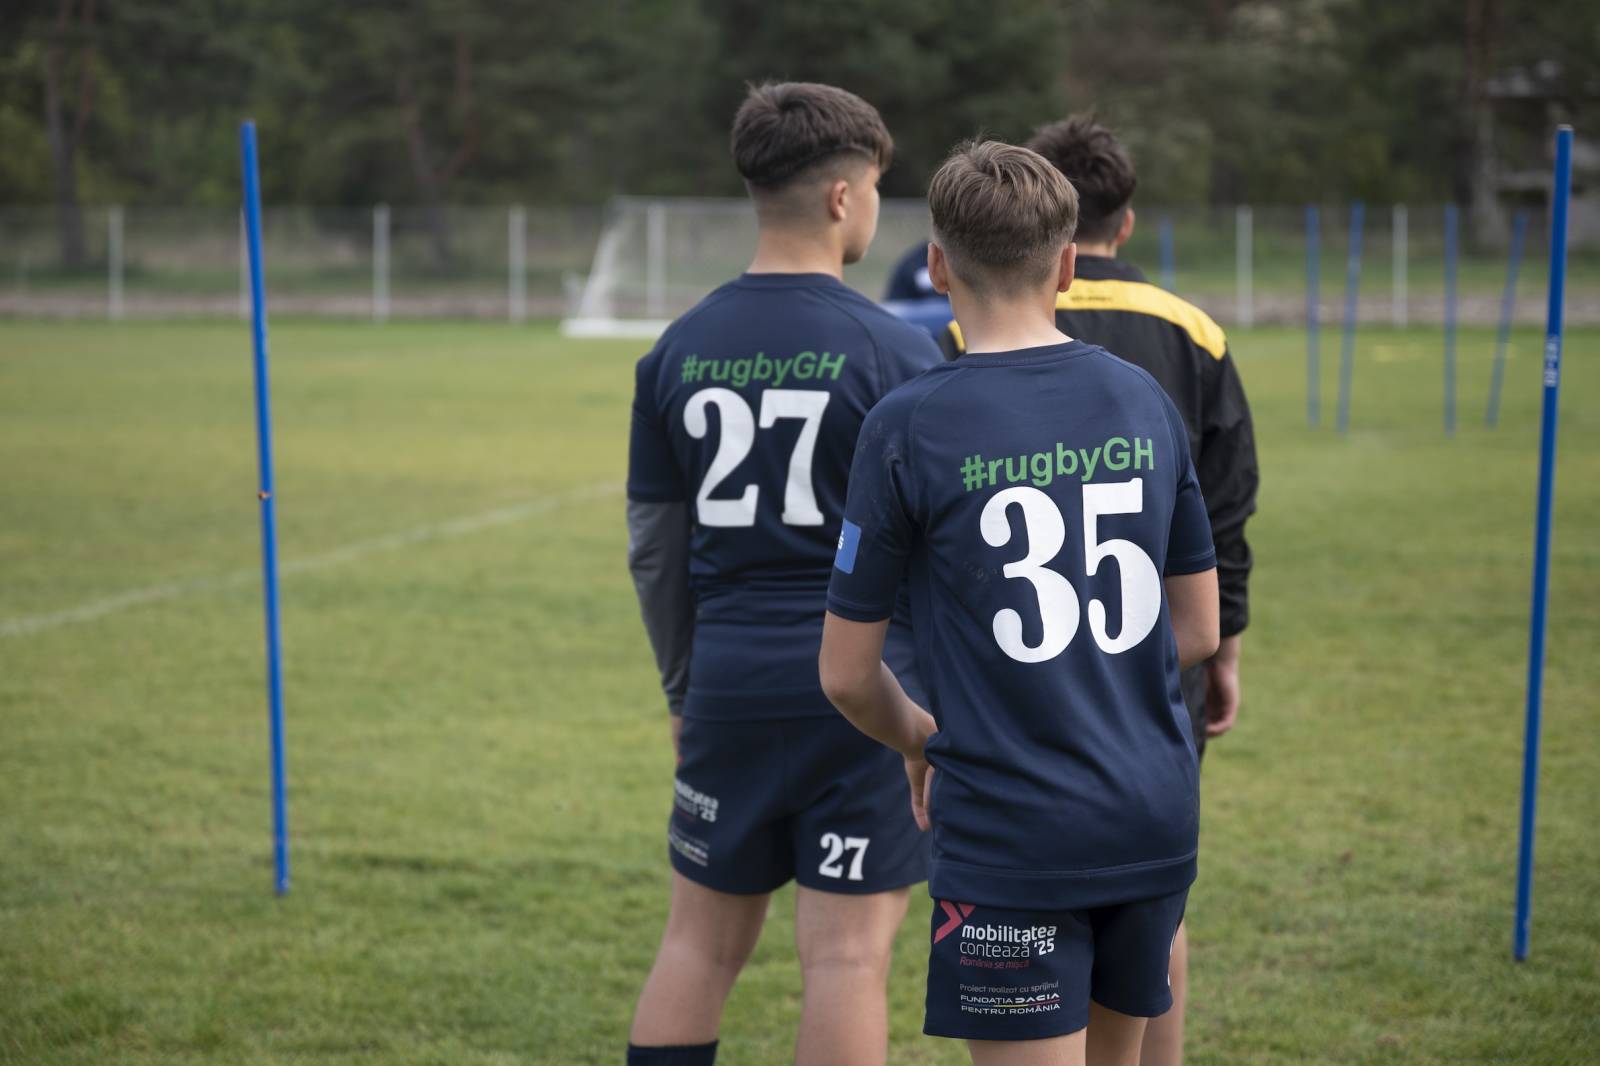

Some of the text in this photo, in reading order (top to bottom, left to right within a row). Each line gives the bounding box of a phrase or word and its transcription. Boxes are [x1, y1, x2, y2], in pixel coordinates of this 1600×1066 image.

[680, 351, 847, 388] #rugbyGH
[683, 387, 831, 527] 27
[960, 437, 1155, 492] #rugbyGH
[980, 477, 1162, 663] 35
[818, 832, 870, 881] 27
[961, 924, 1057, 943] mobilitatea
[961, 1003, 1061, 1015] PENTRU ROMÂNIA
[1015, 992, 1060, 1004] DACIA
